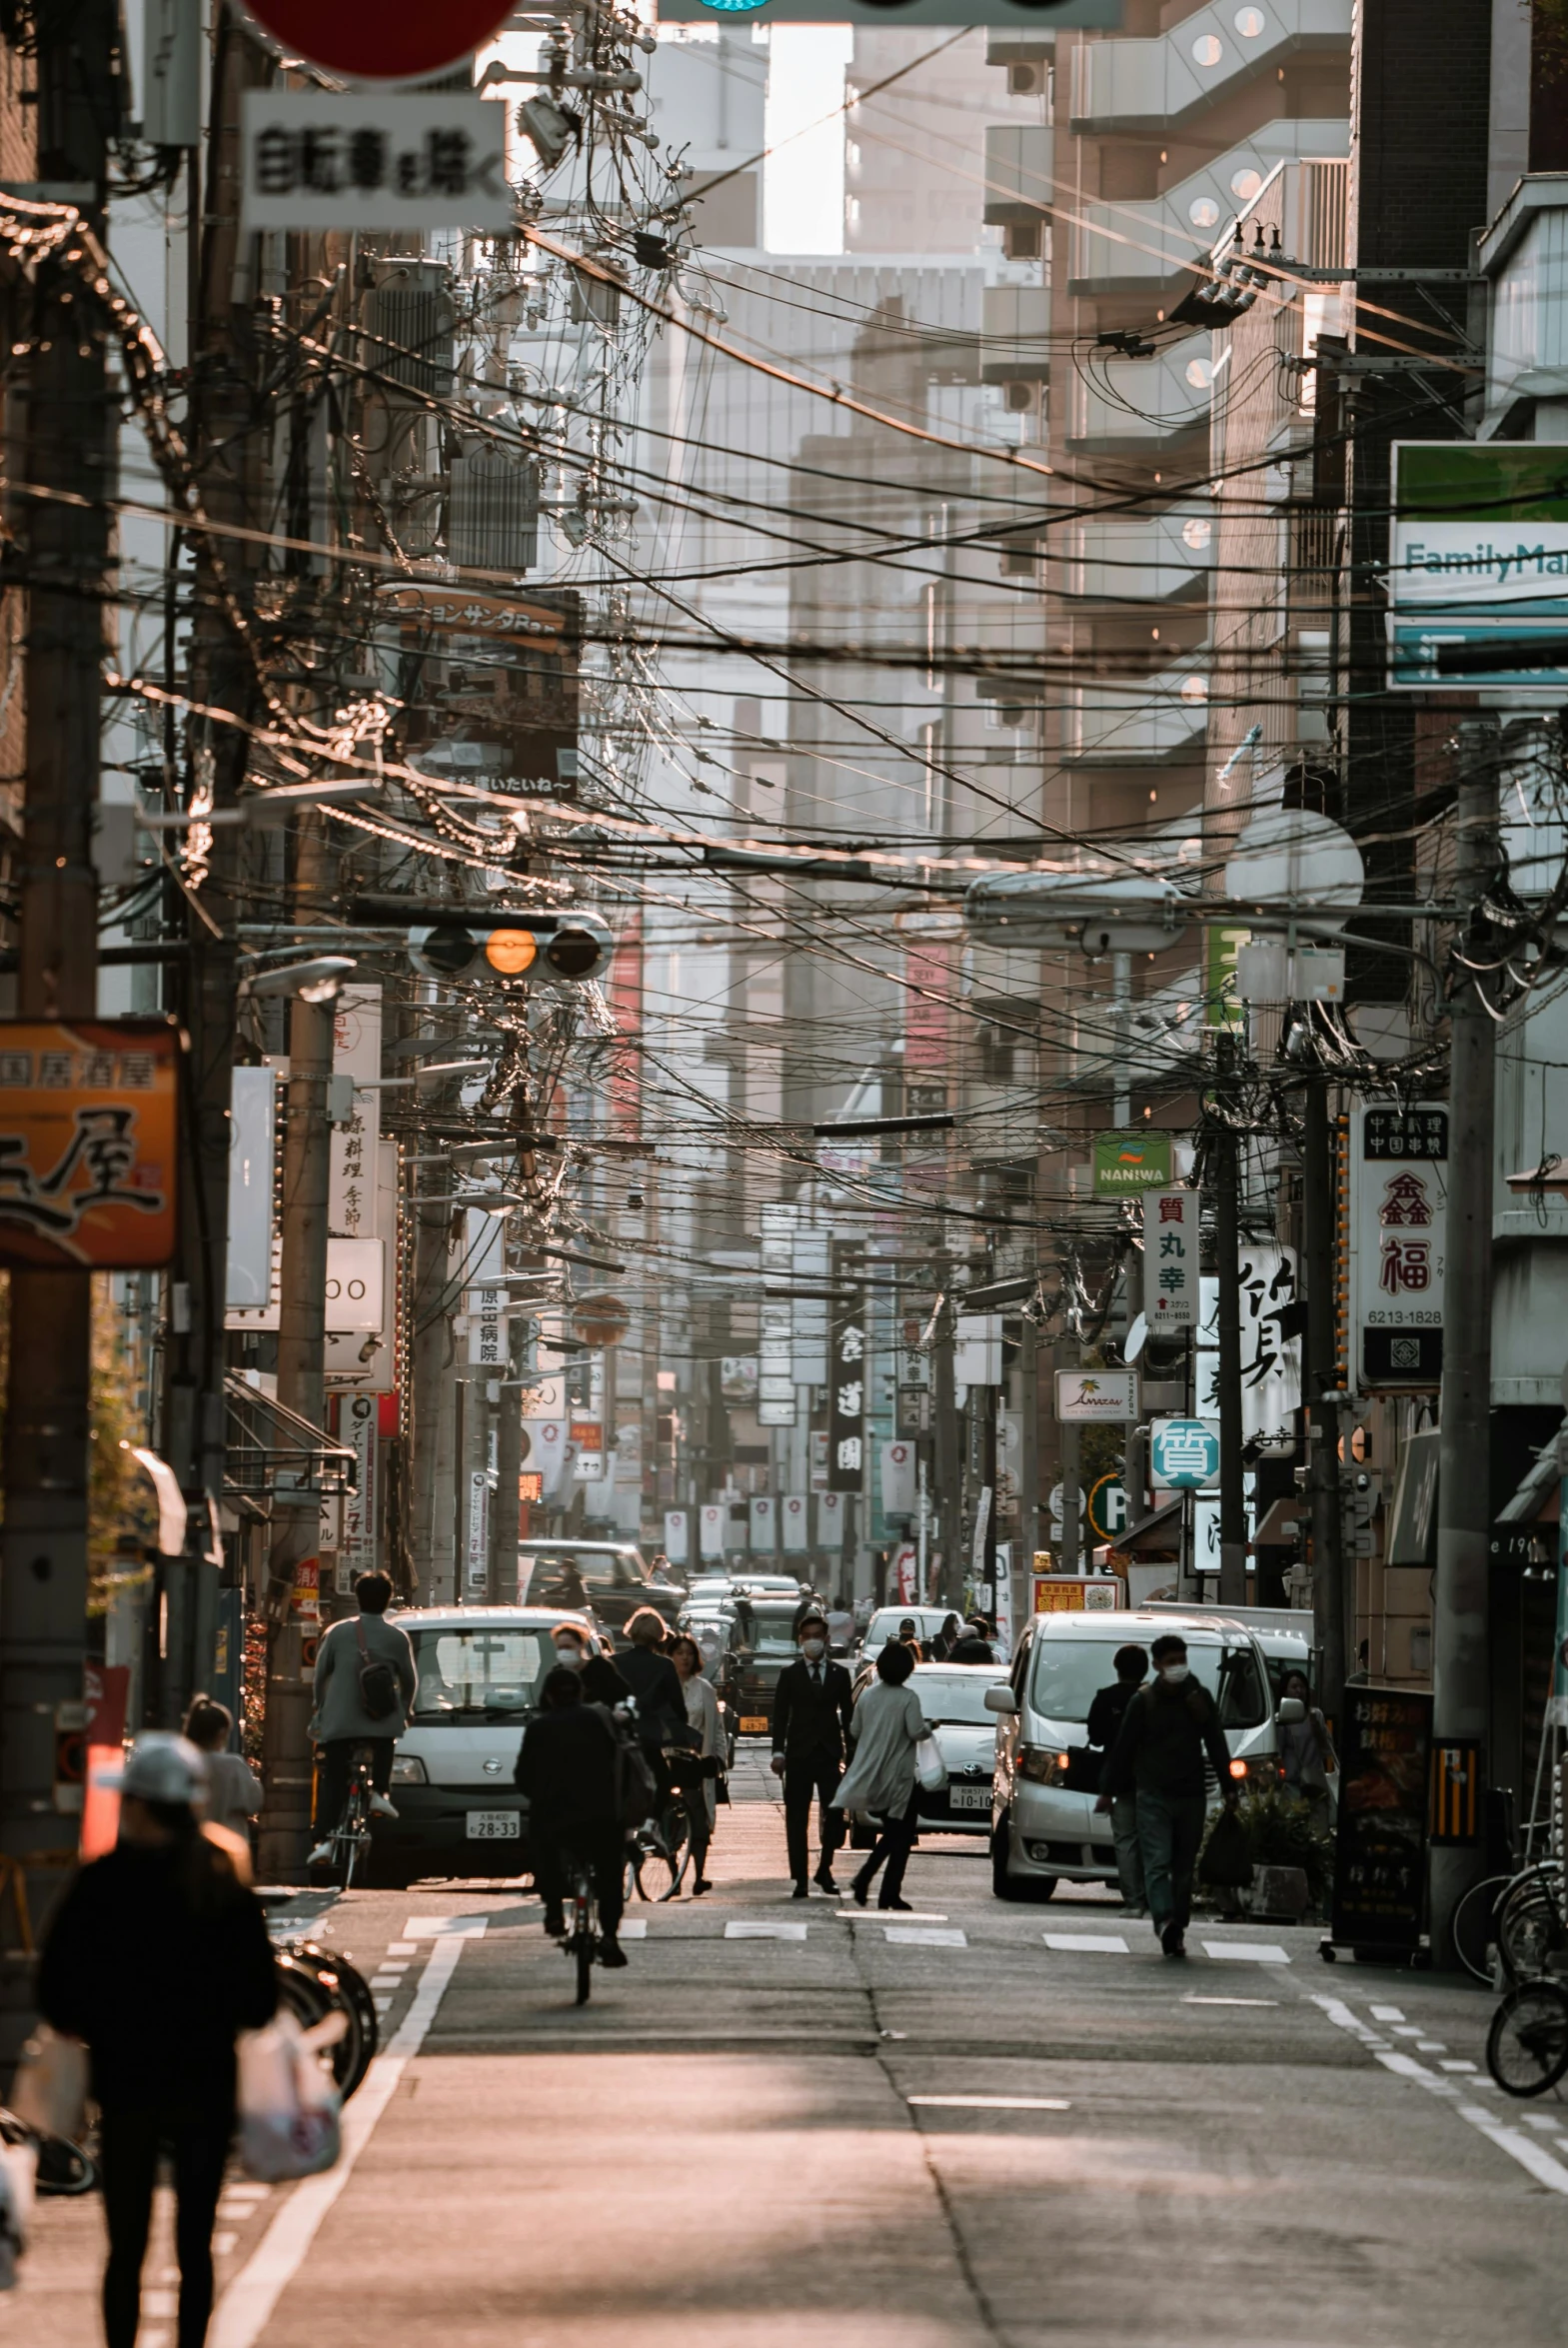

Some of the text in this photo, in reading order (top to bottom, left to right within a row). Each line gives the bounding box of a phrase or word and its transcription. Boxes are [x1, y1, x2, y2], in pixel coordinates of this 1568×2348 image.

[254, 121, 505, 200] 自転車を除く
[1100, 1169, 1163, 1181] NANIWA
[1380, 1172, 1432, 1295] 鑫福
[1368, 1310, 1442, 1324] 6213-1828
[1157, 1428, 1215, 1480] 質
[1106, 1487, 1127, 1529] P
[960, 1795, 991, 1807] 10-10
[478, 1821, 518, 1837] 28-33
